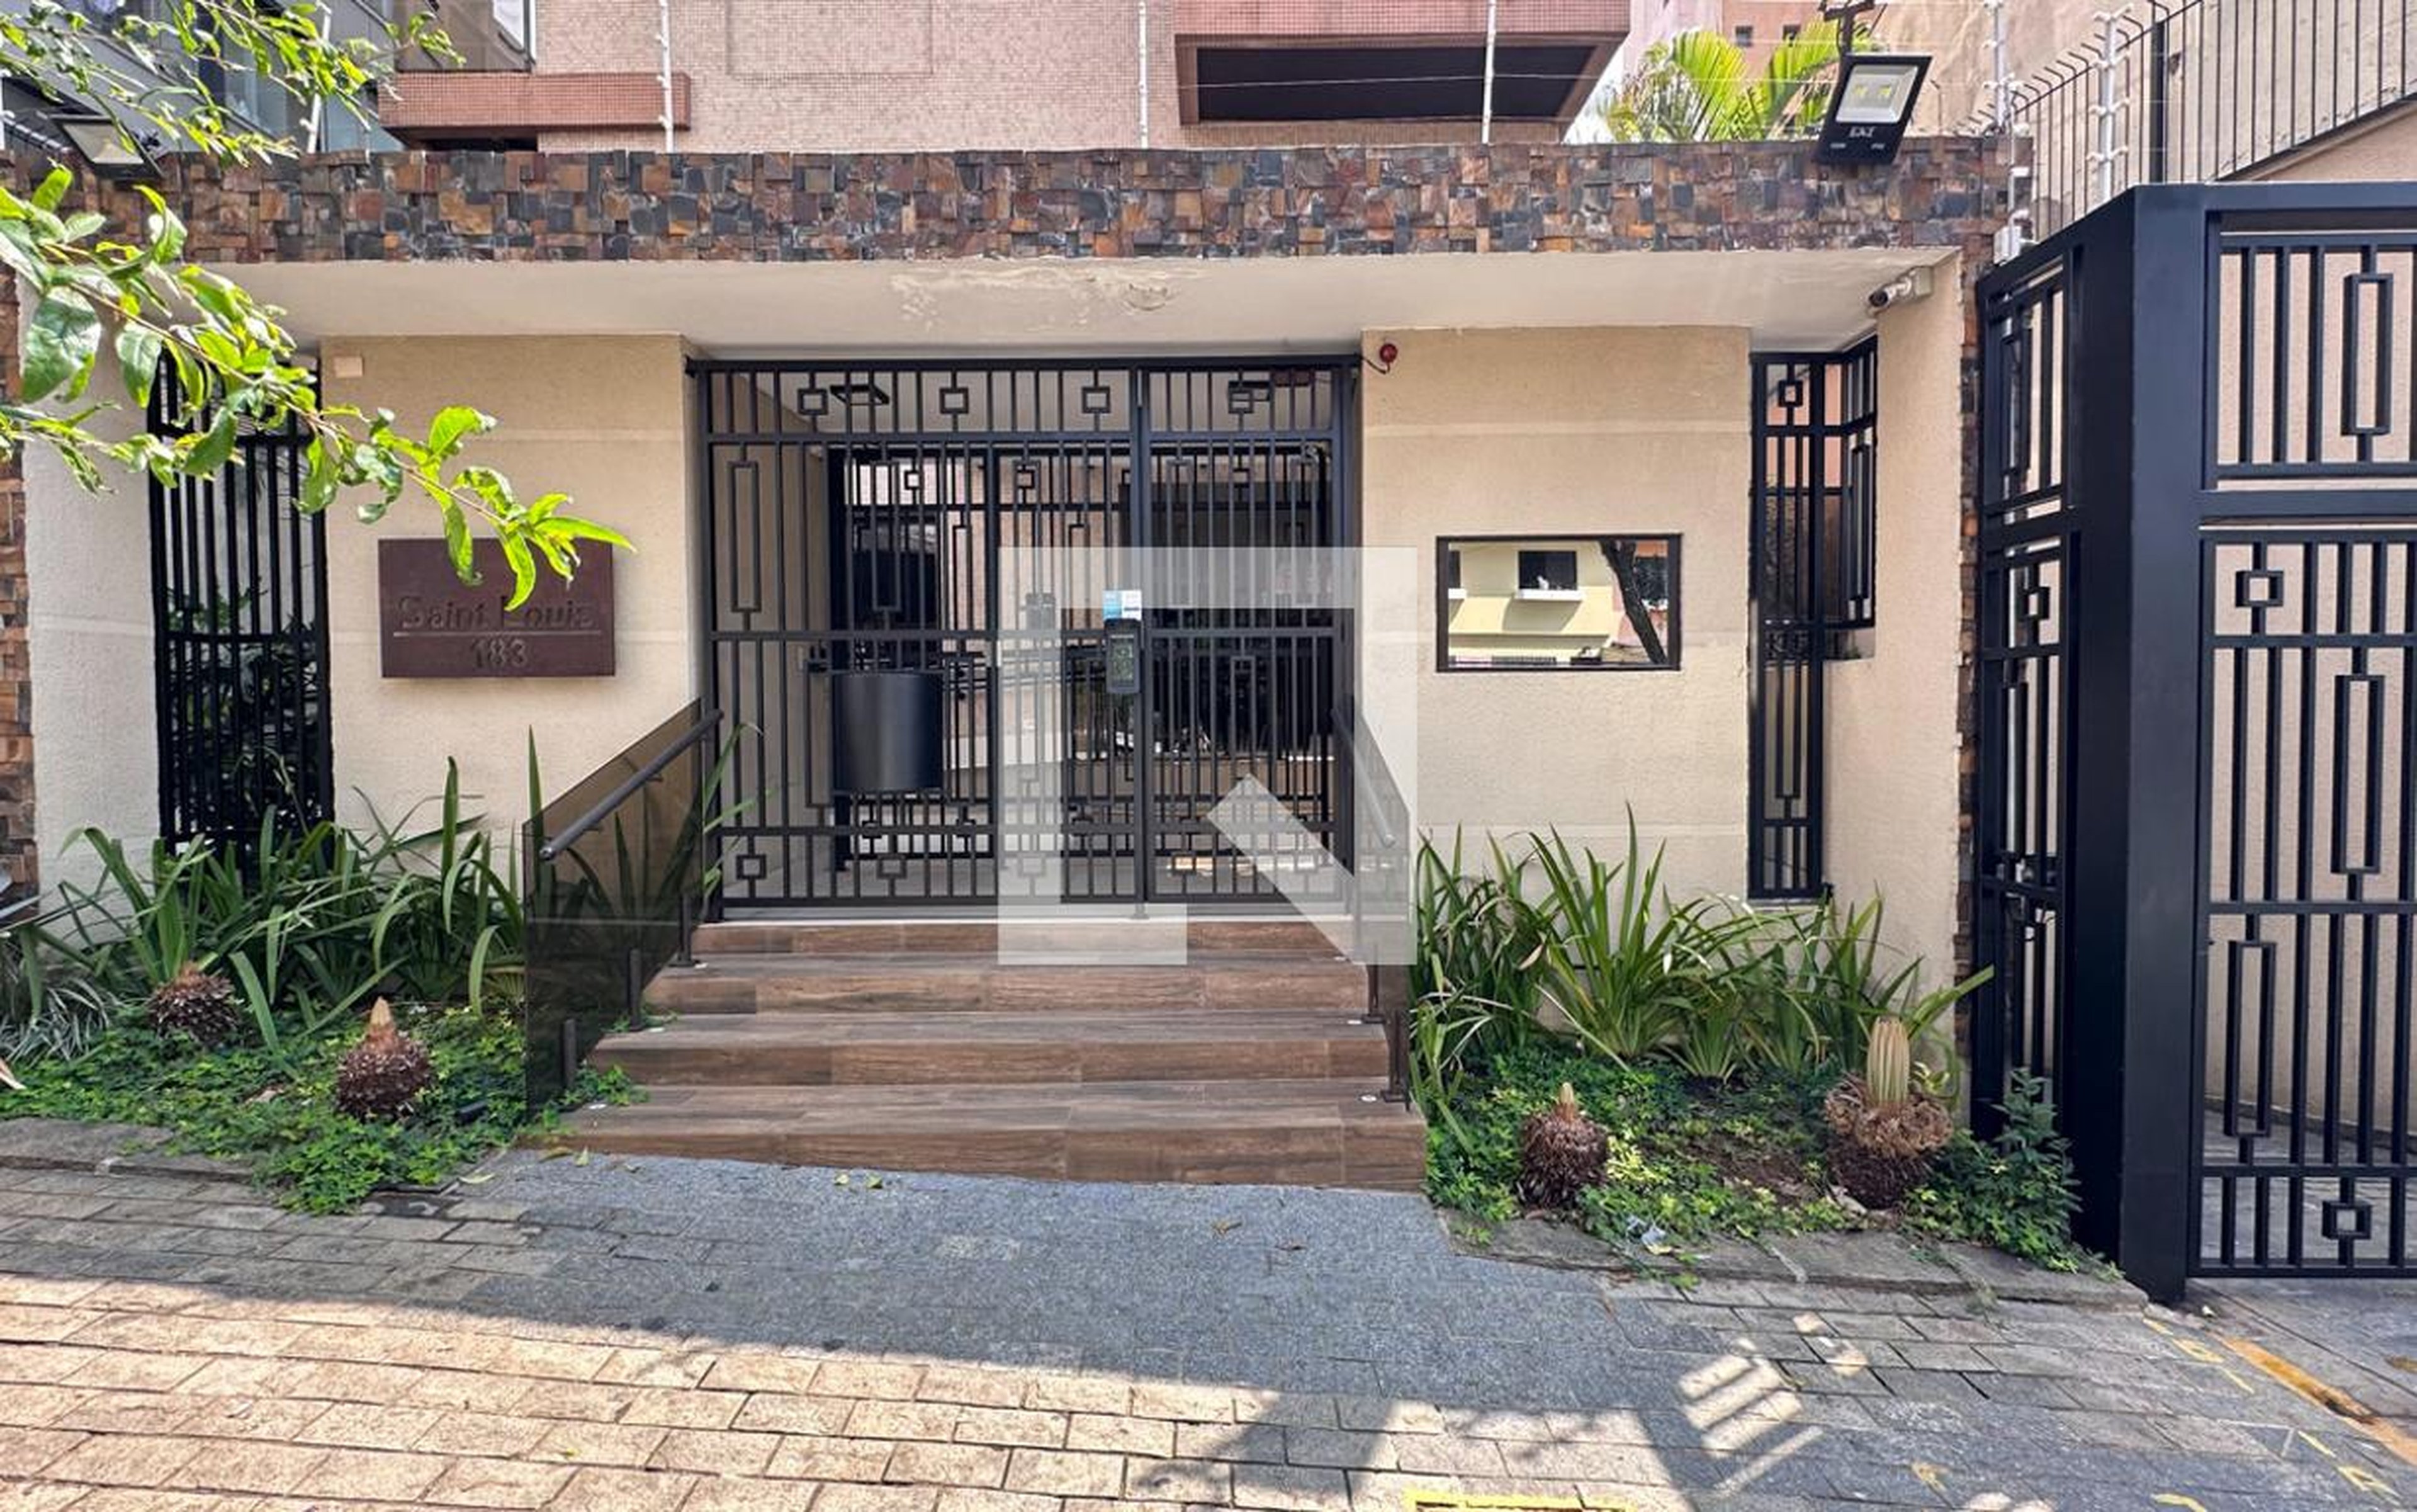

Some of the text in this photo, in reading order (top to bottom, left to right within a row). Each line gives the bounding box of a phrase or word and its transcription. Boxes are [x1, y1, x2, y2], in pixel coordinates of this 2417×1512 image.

[398, 594, 596, 629] Saint Louis
[471, 638, 529, 669] 183
